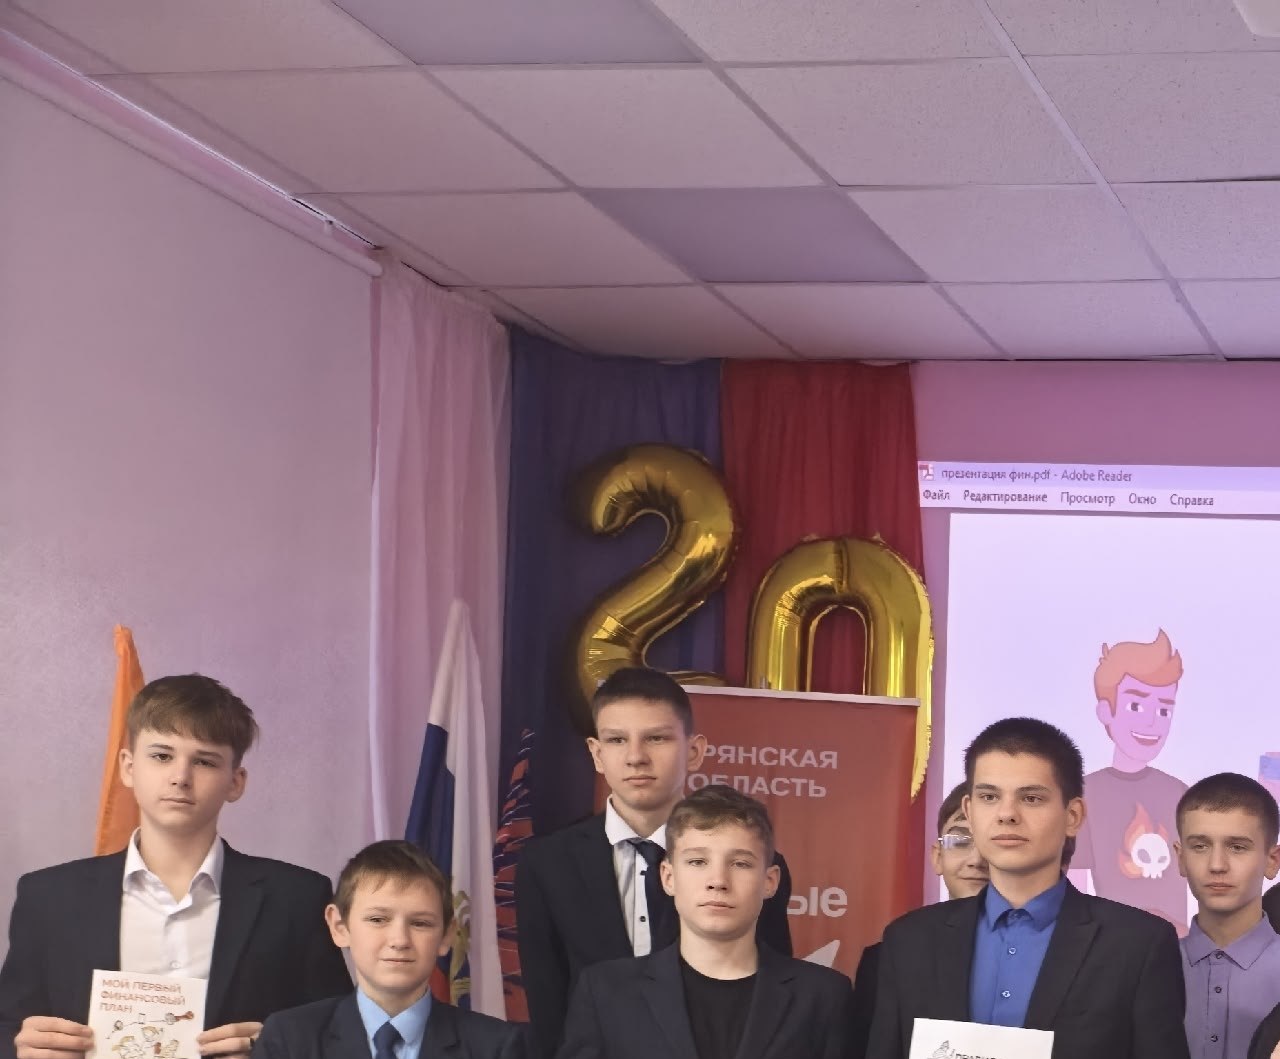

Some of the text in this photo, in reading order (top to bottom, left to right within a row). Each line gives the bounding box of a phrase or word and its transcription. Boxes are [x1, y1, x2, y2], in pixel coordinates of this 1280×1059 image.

[941, 469, 1007, 481] презентация
[1009, 467, 1051, 483] фин.pdf
[1061, 469, 1095, 482] Adobe
[1097, 469, 1133, 482] Reader
[922, 489, 1214, 508] Файл Редактирование Просмотр Окно Справка
[703, 744, 838, 769] РЯНСКАЯ
[102, 979, 182, 994] МОЙ ПЕРВЫЙ
[100, 990, 186, 1006] ФИНАНСОВЫЙ
[99, 1002, 133, 1014] ПЛАН
